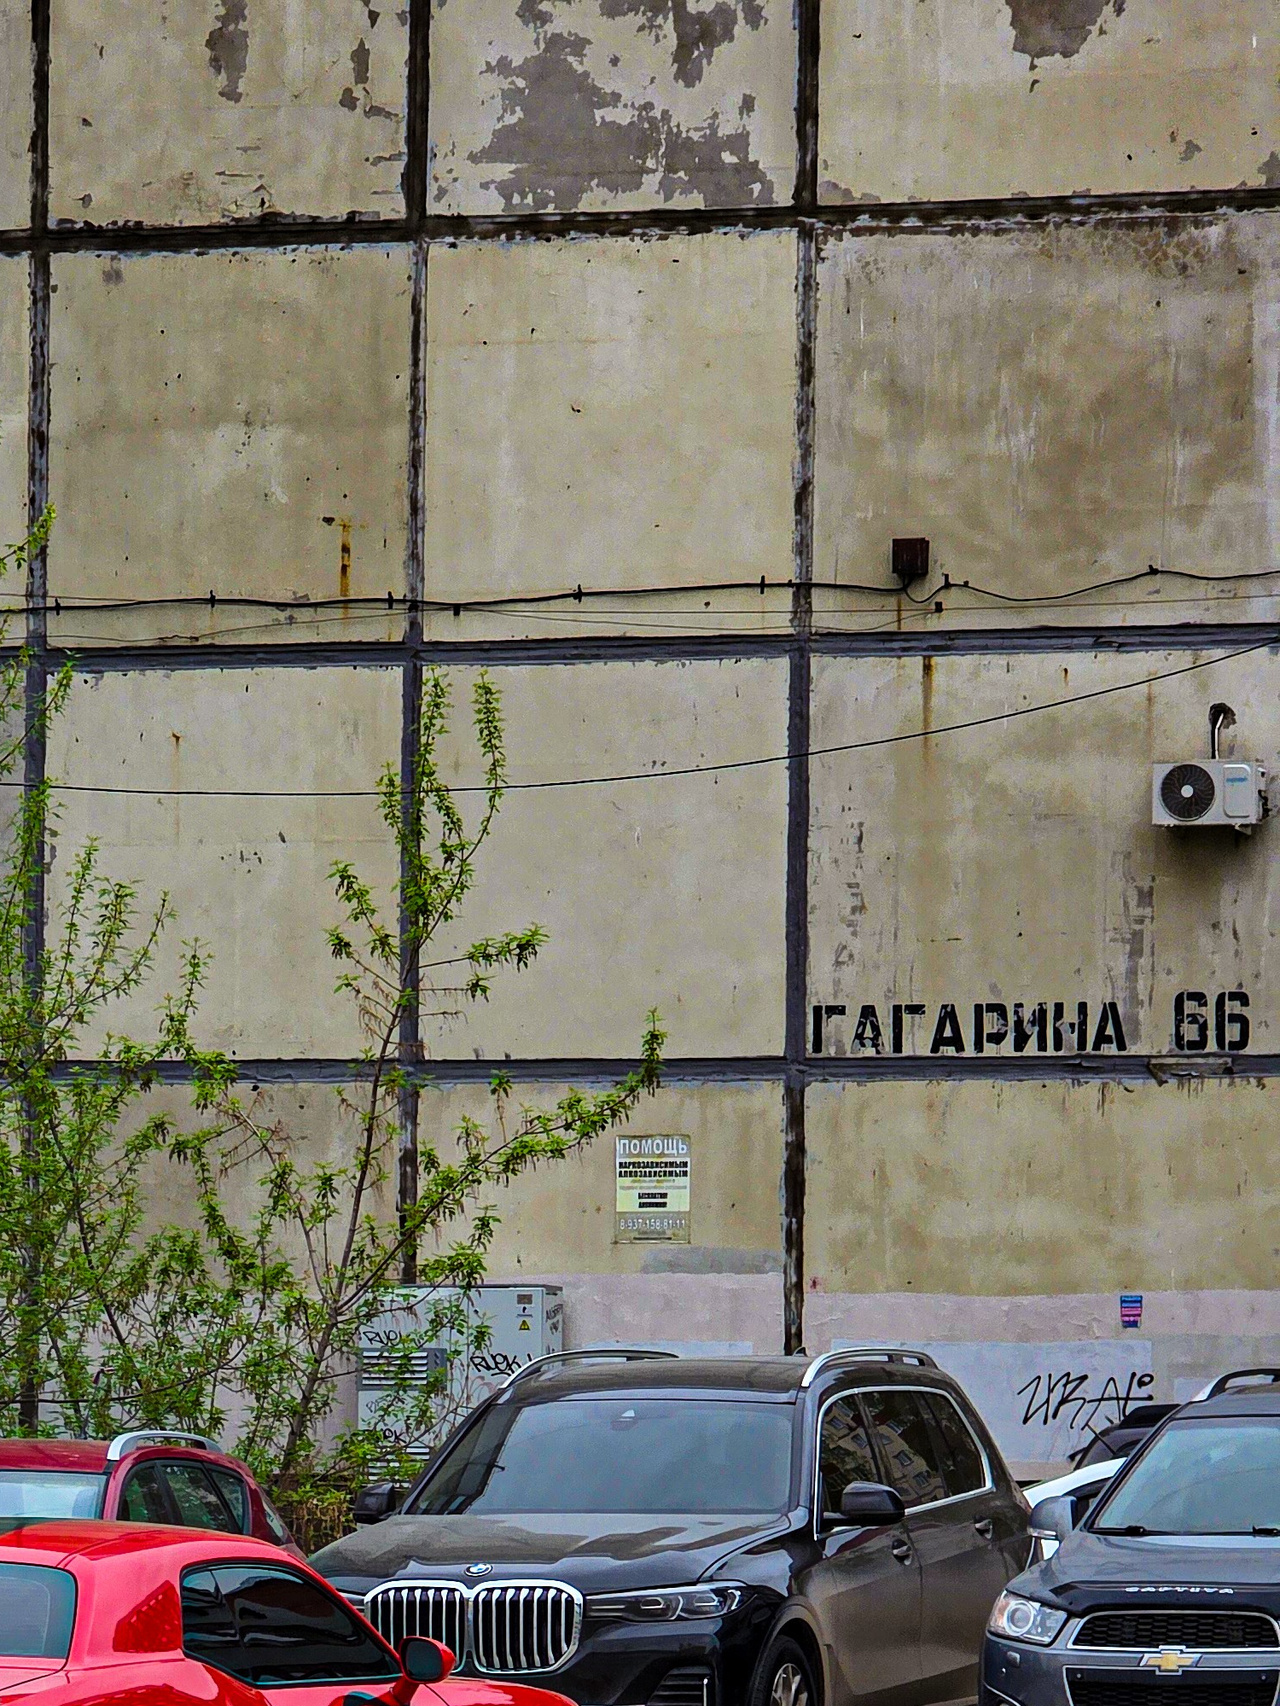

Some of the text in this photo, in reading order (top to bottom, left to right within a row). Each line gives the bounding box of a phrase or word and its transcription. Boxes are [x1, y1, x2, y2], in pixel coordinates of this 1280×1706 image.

[811, 991, 1250, 1054] ГАГАРИНА 66
[619, 1138, 687, 1156] ПОМОЩЬ
